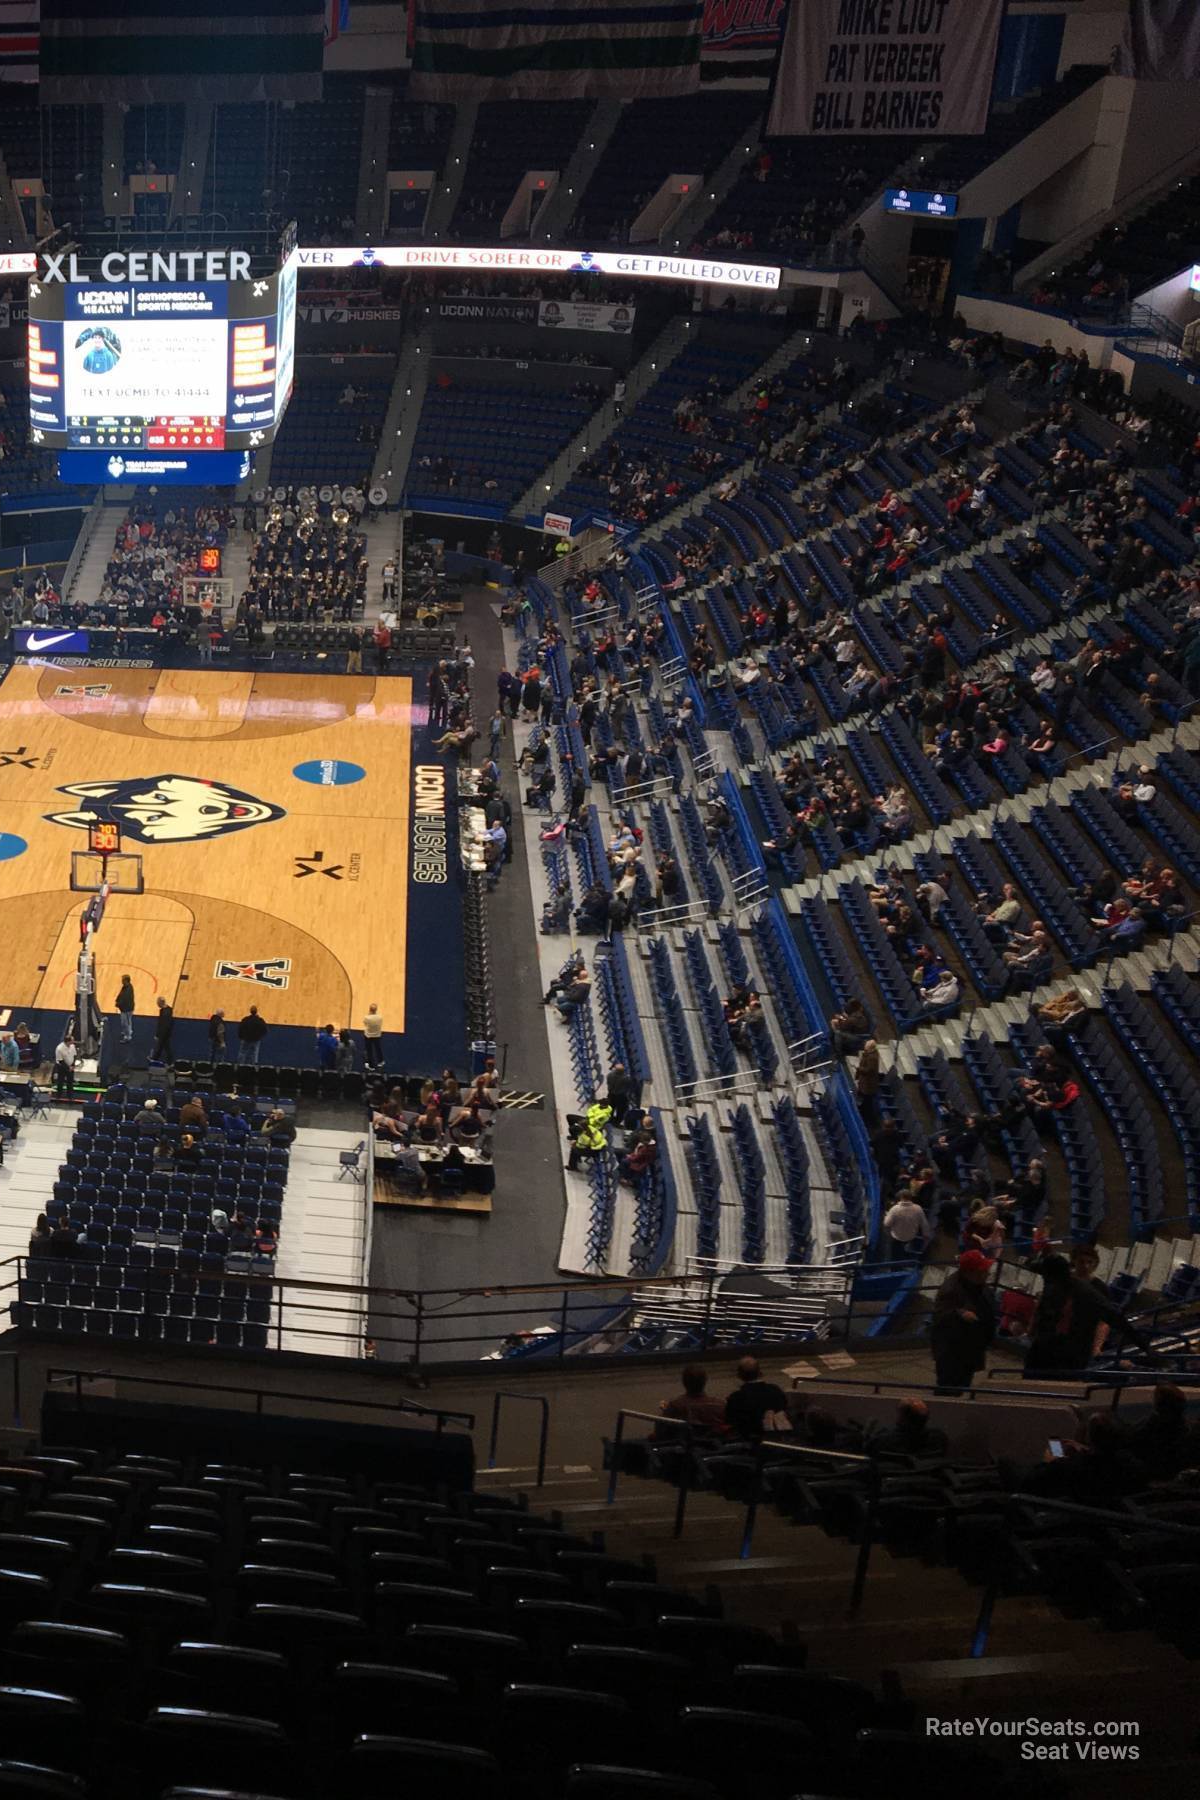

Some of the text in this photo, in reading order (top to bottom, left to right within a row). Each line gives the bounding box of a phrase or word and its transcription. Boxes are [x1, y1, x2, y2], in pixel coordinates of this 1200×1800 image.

[837, 0, 891, 35] MIKE
[825, 44, 947, 82] PAT VERBEEK
[813, 91, 944, 130] BILL BARNES
[41, 251, 251, 283] XL CENTER
[406, 251, 461, 264] DRIVE
[468, 252, 531, 265] SOBER
[536, 253, 562, 266] OR
[616, 258, 652, 271] GET
[658, 260, 724, 278] PULLED
[728, 267, 776, 285] OVER
[78, 291, 129, 305] UCONN
[83, 305, 124, 314] HEALTH
[348, 310, 400, 321] HUSKIES
[439, 305, 484, 317] UCONN
[545, 518, 569, 531] ESPN
[203, 555, 217, 567] 30
[412, 765, 448, 884] UCONN HUSKIES
[350, 852, 362, 873] CENTER
